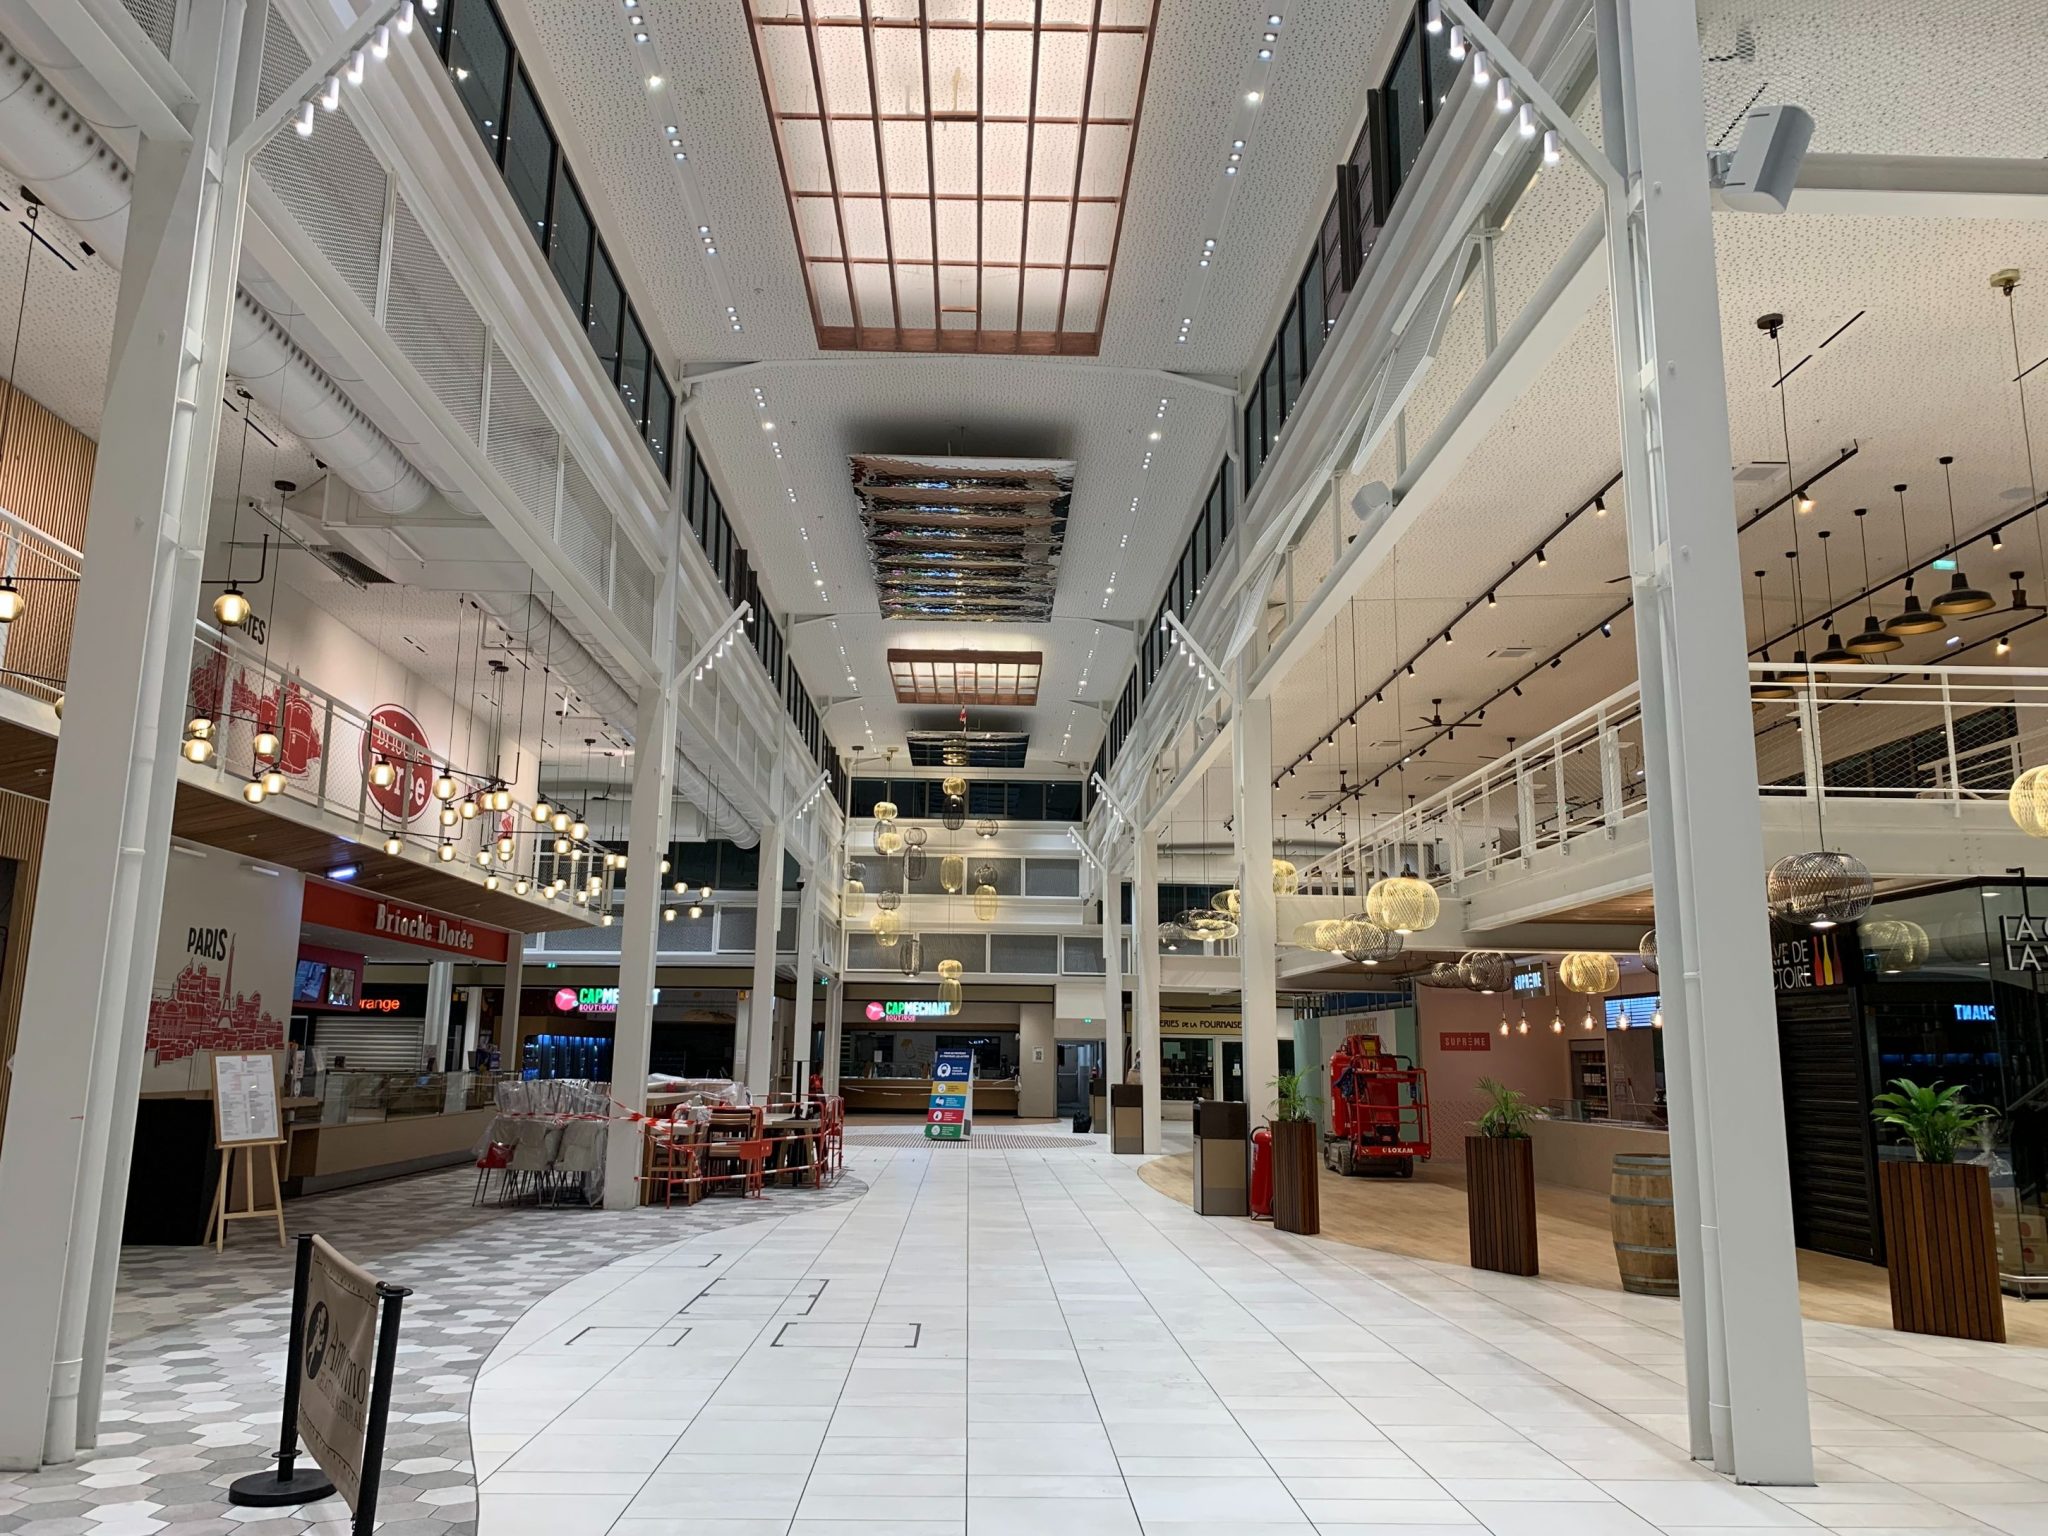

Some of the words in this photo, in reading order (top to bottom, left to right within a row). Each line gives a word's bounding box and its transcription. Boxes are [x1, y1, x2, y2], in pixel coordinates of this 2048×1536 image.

[375, 903, 433, 941] Brioche
[437, 919, 474, 950] Dorée
[187, 927, 228, 962] PARIS
[1791, 939, 1809, 964] DE
[359, 998, 400, 1012] range
[1160, 1020, 1180, 1028] ERIES
[1199, 1020, 1242, 1029] FOURNAISE
